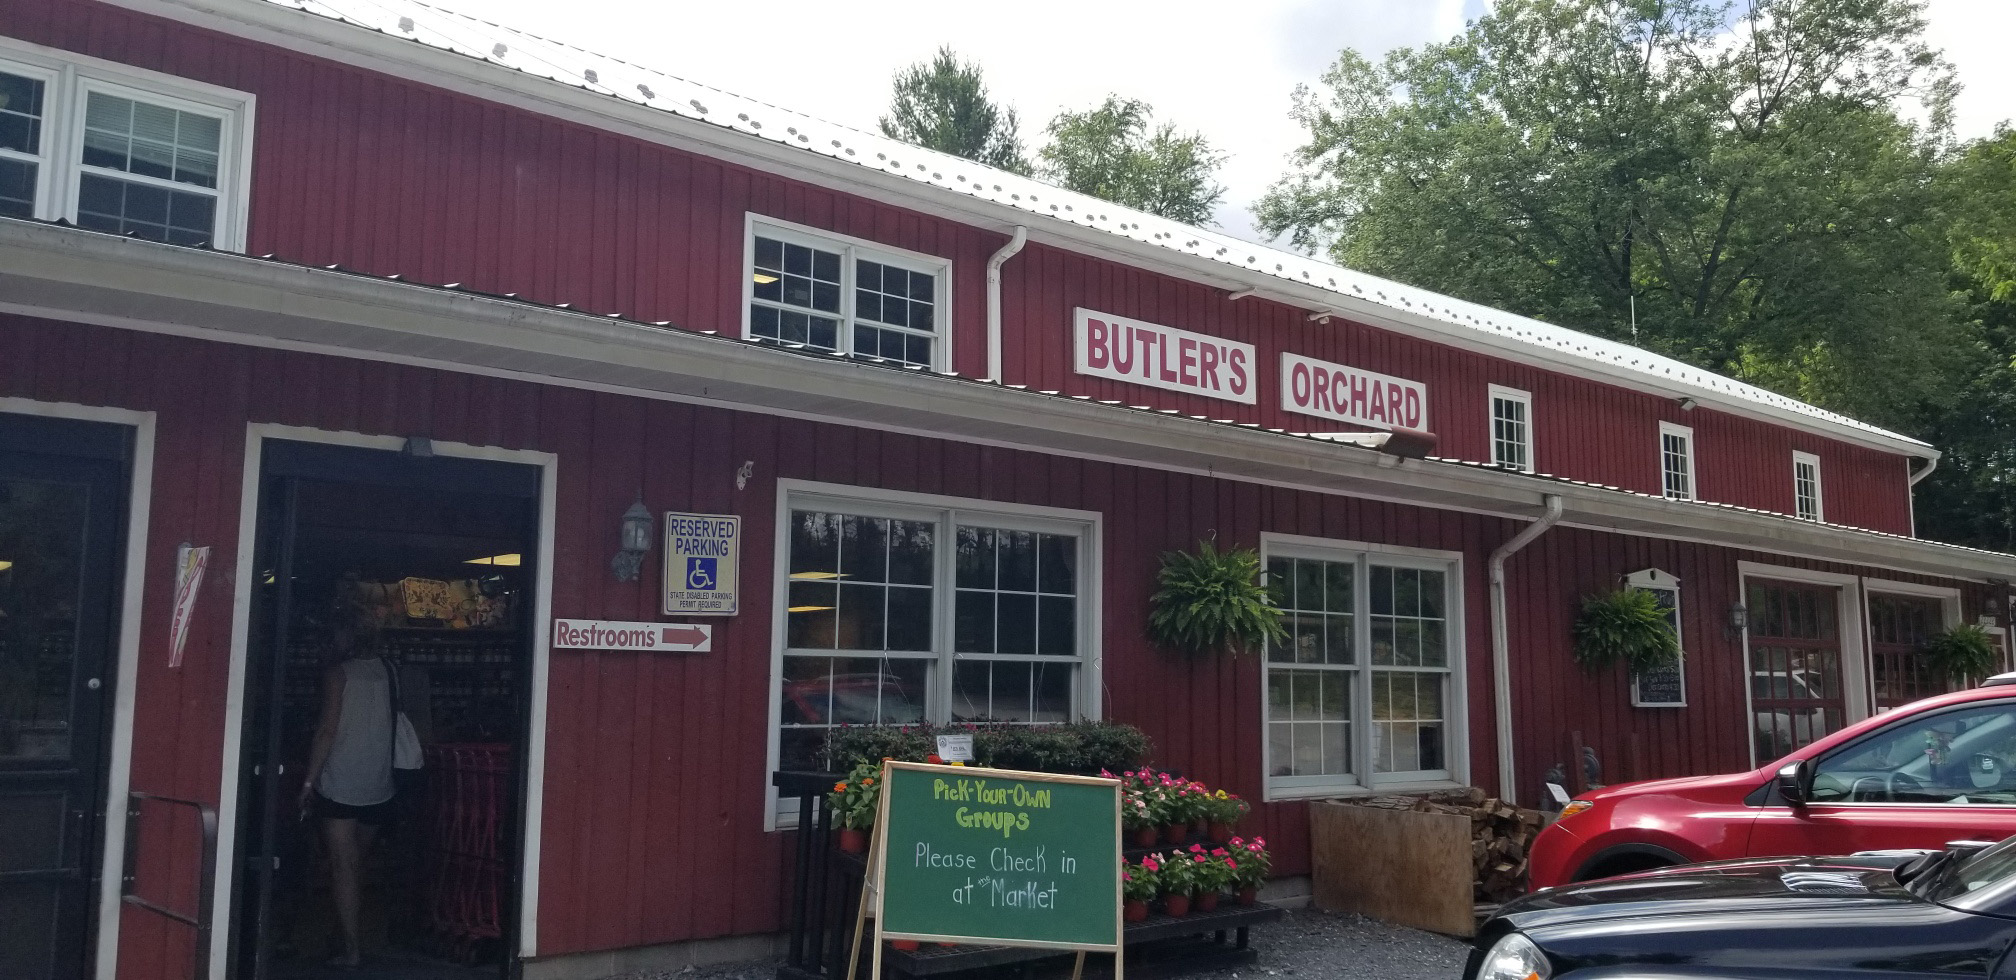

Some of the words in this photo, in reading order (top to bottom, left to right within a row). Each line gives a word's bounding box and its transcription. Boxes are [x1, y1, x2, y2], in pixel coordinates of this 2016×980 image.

[1087, 318, 1247, 396] BUTLER'S
[1291, 362, 1421, 429] ORCHARD
[671, 519, 735, 538] RESERVED
[675, 538, 729, 556] PARKING
[670, 591, 685, 599] STATE
[686, 592, 710, 600] DISABLED
[711, 592, 733, 600] PARKING
[679, 600, 697, 608] PERMIT
[698, 601, 722, 609] REQUIRED
[557, 621, 656, 647] Restrooms
[915, 841, 976, 868] Please
[1061, 850, 1076, 874] in
[952, 876, 974, 904] at
